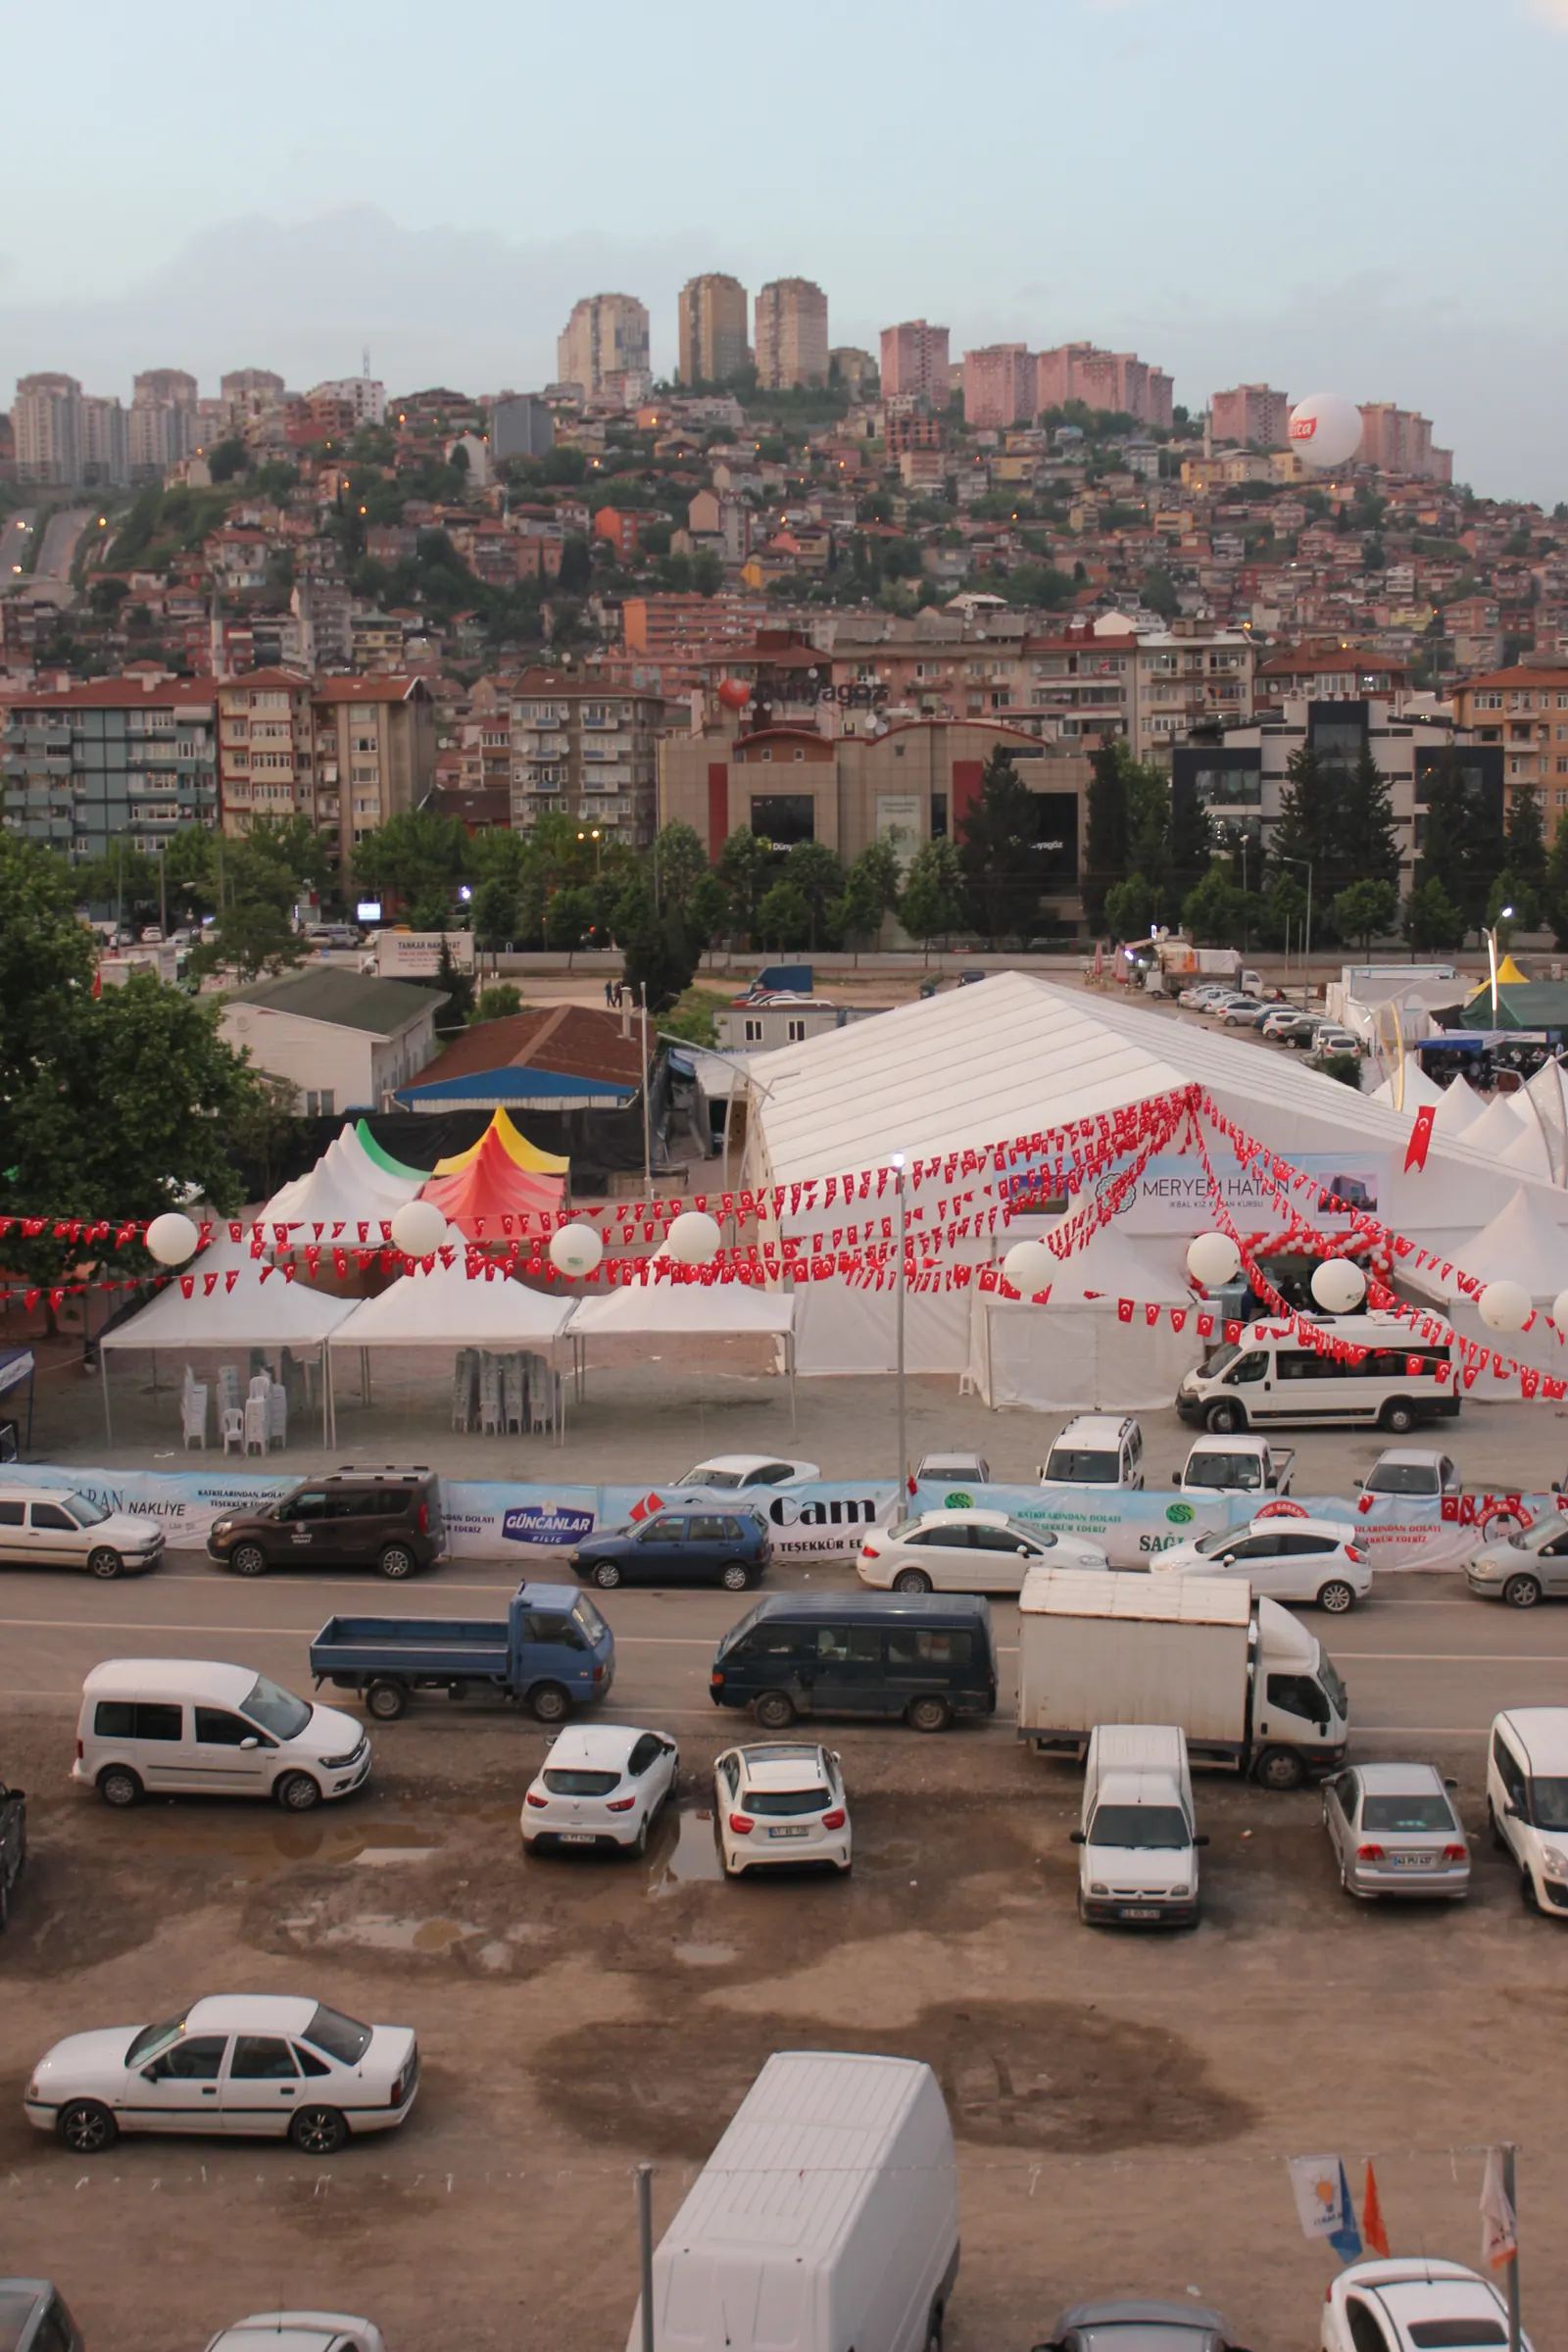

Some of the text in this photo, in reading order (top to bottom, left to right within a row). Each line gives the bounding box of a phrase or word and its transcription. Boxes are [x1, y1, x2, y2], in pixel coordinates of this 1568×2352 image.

[1143, 1178, 1223, 1197] MERYEM
[1237, 1200, 1264, 1208] KURSU
[128, 1499, 186, 1517] NAKLİYE
[769, 1496, 876, 1527] Cam
[465, 1515, 495, 1524] DOLAYI
[506, 1512, 591, 1532] GÜNCANLAR
[1089, 1514, 1122, 1523] DOLAYI
[454, 1524, 482, 1534] EDERİZ
[1076, 1523, 1107, 1534] EDERİZ
[1408, 1524, 1442, 1533] DOLAYI
[1396, 1535, 1428, 1544] EDERİZ
[780, 1538, 844, 1554] TEŞEKKÜR
